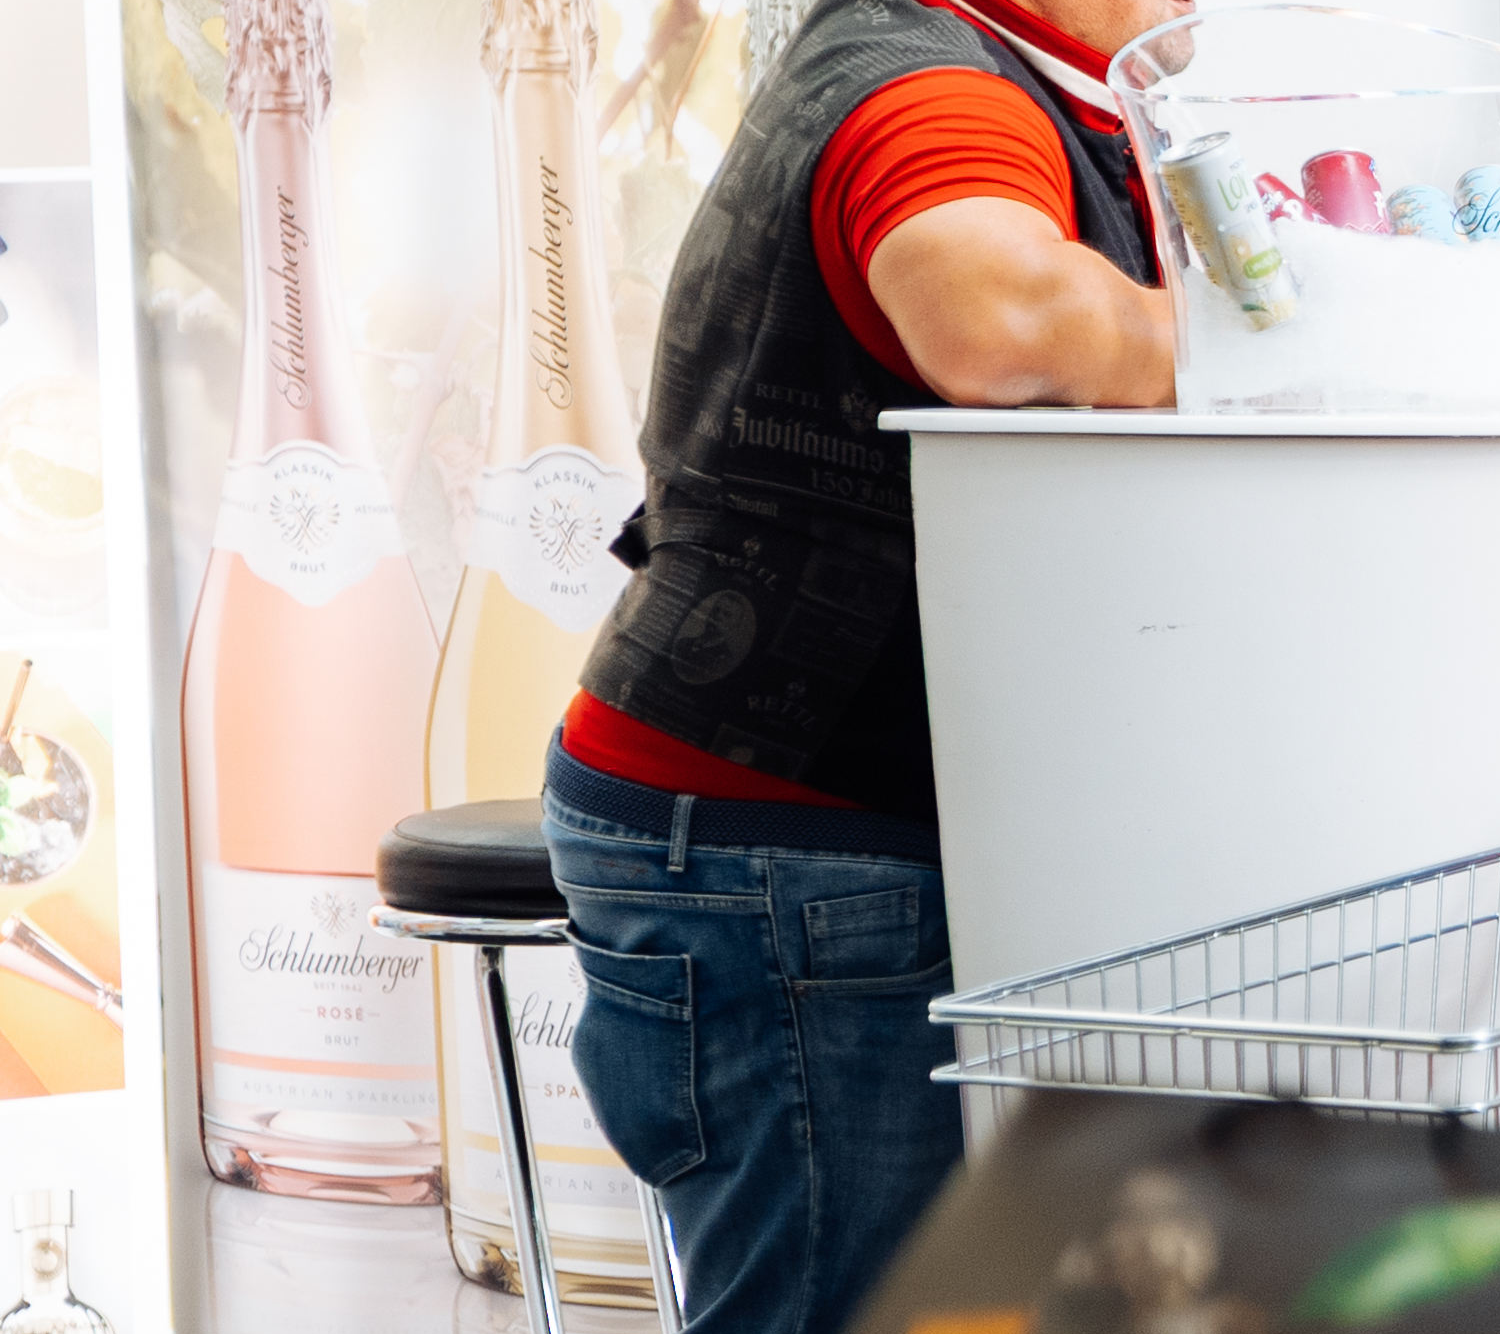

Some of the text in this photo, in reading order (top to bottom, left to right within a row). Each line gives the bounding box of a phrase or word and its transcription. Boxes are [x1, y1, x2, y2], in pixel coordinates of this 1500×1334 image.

[527, 154, 576, 410] Schlumberger
[264, 184, 313, 410] Schlumberger
[273, 463, 334, 483] KLASSIK
[532, 470, 597, 493] KLASSIK
[289, 560, 328, 574] BRUT
[549, 581, 590, 597] BRUT
[239, 923, 425, 993] Schlumberger
[317, 1003, 365, 1022] ROSÉ
[324, 1034, 360, 1047] BRUT
[242, 1080, 334, 1100] AUSTRIAN
[495, 1168, 594, 1192] ARIAN
